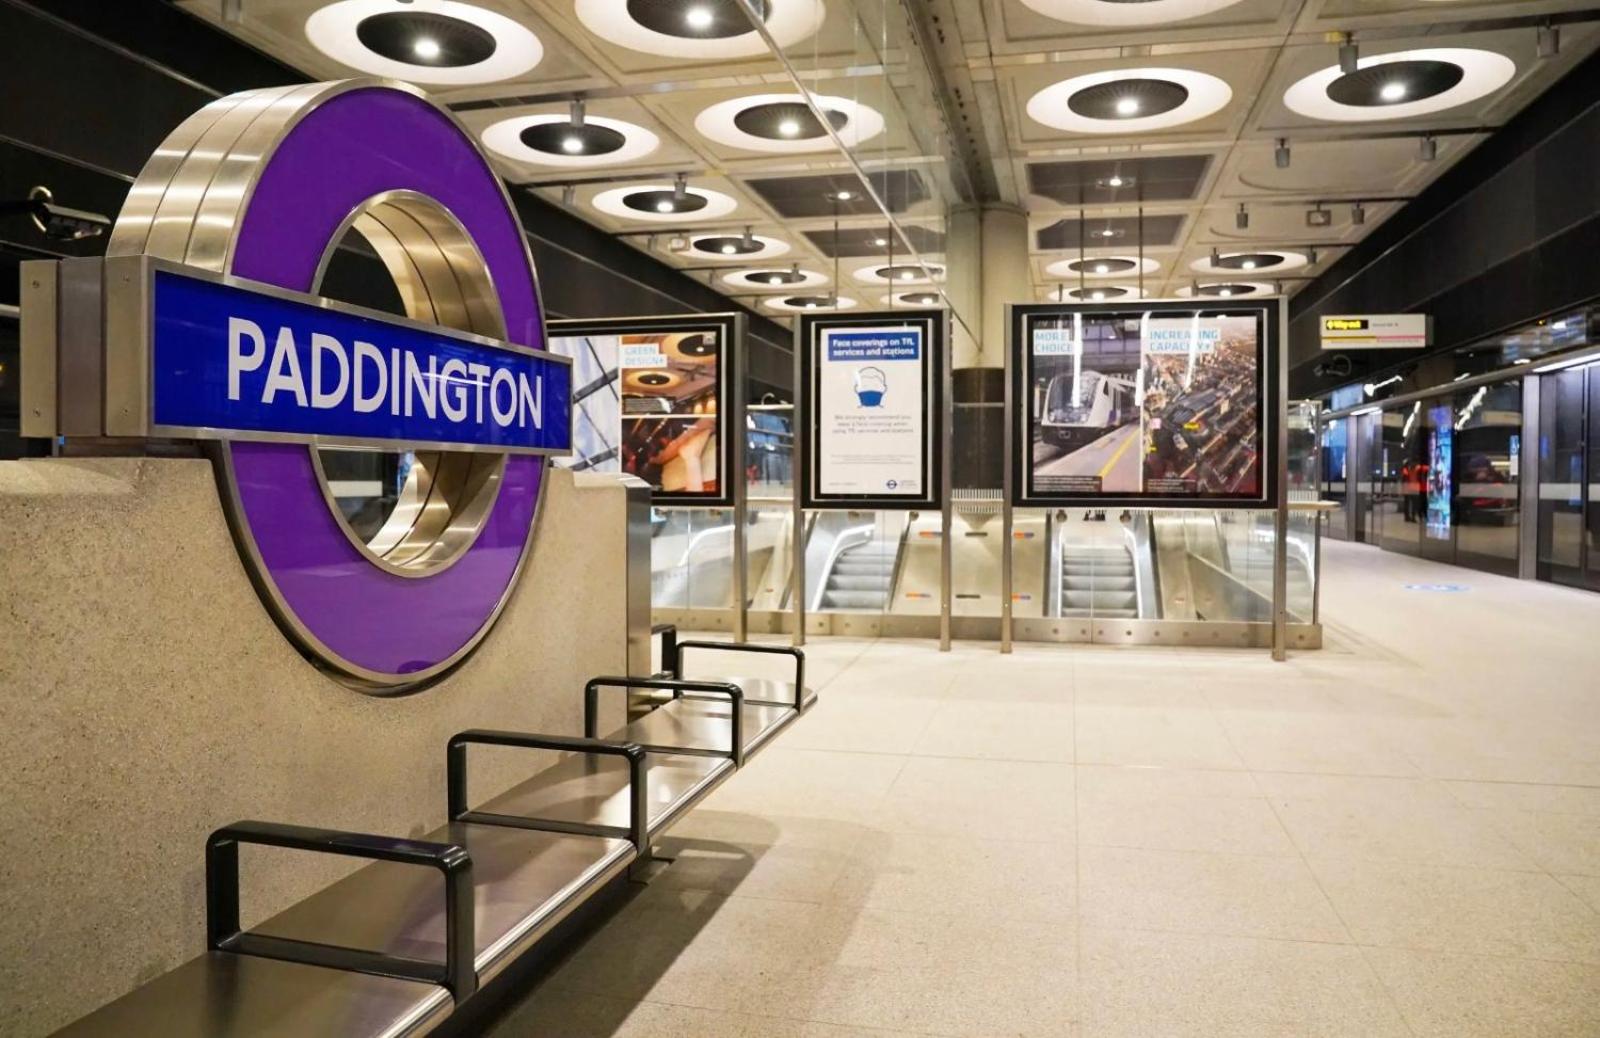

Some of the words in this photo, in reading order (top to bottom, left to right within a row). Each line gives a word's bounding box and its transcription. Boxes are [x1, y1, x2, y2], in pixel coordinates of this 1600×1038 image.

[1035, 331, 1068, 341] MORE
[1150, 330, 1218, 340] INCREAING
[833, 339, 851, 348] Face
[852, 339, 888, 348] coverings
[890, 339, 901, 347] on
[1150, 341, 1210, 351] CAPACIY+
[833, 348, 865, 357] services
[866, 348, 881, 356] and
[883, 347, 916, 356] stations
[228, 316, 542, 430] PADDINGTON
